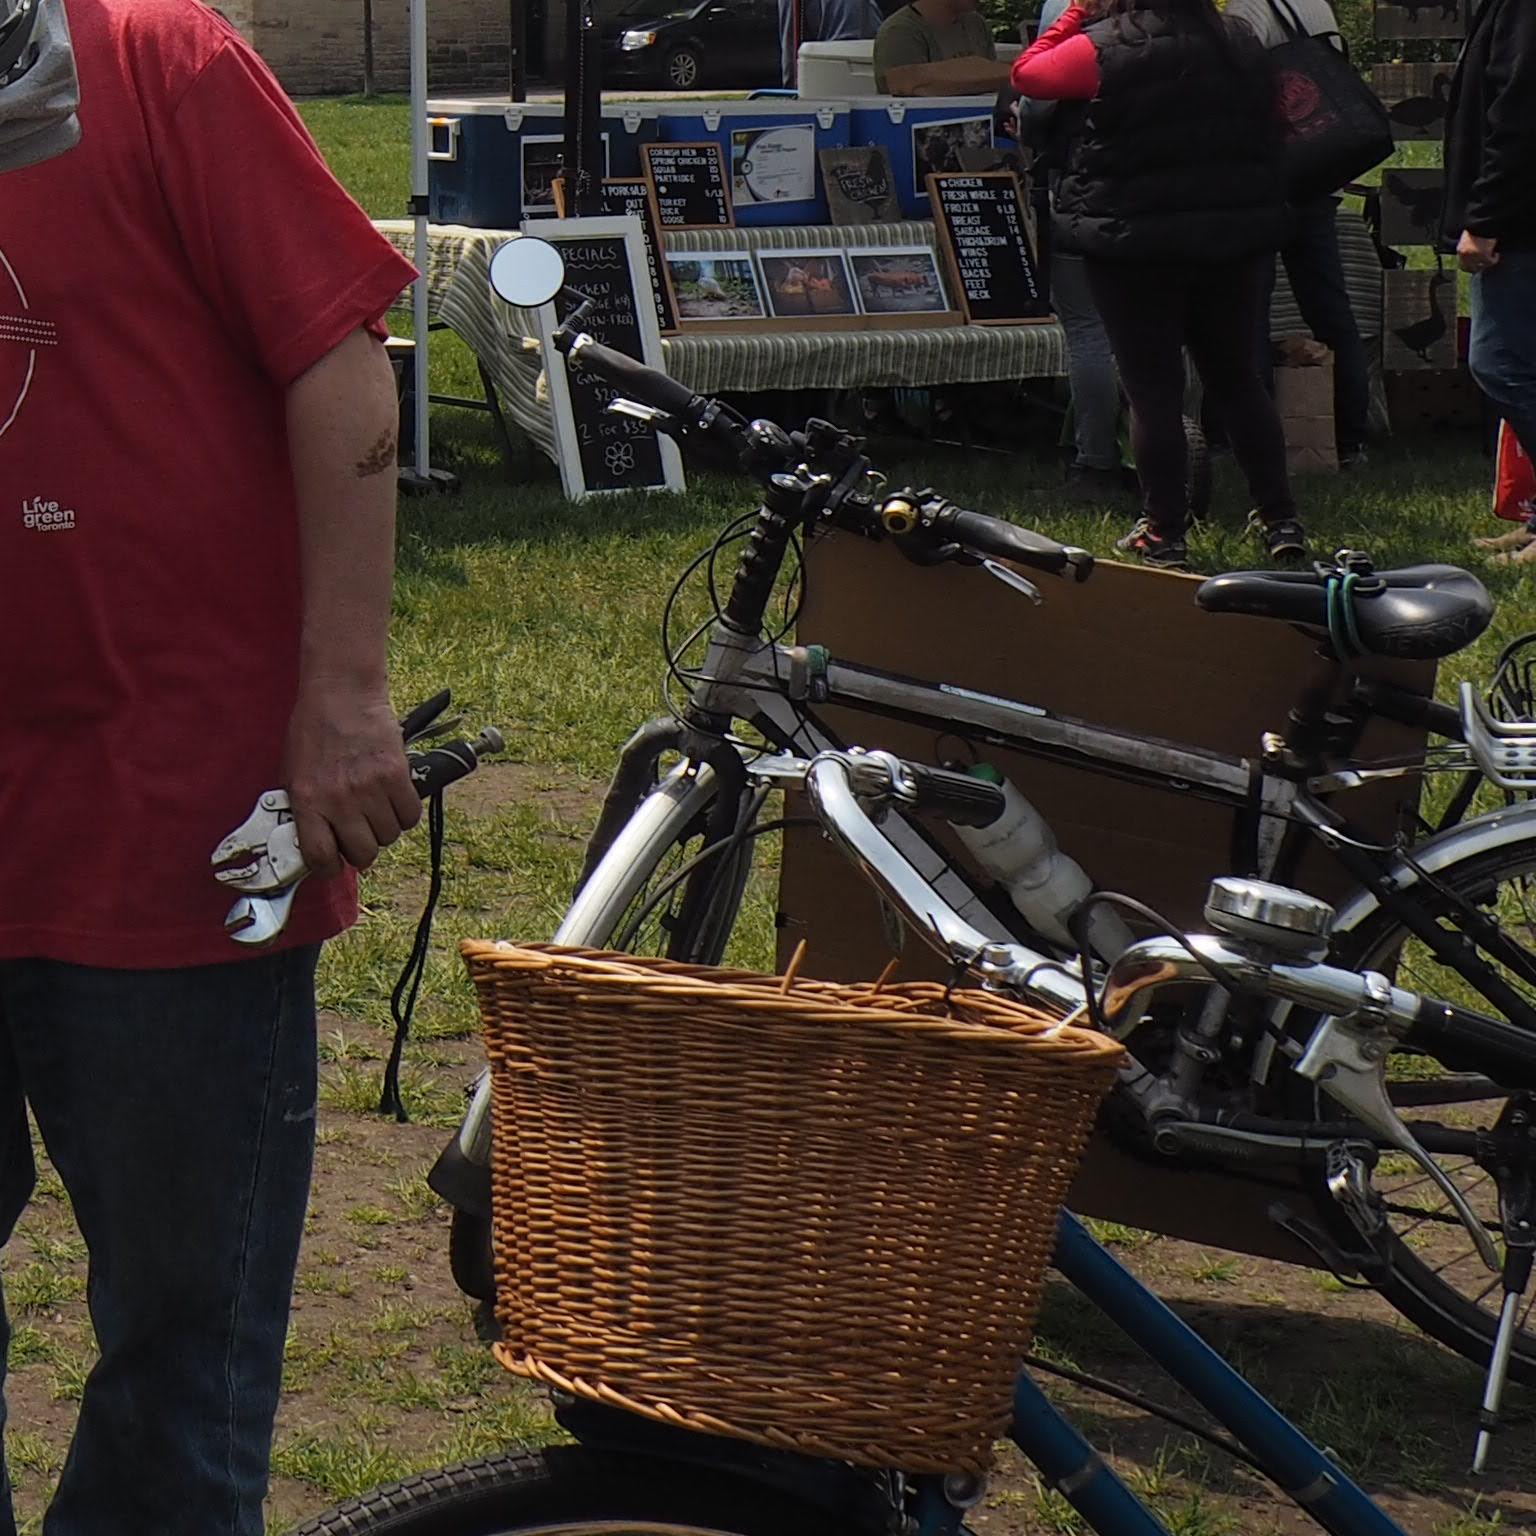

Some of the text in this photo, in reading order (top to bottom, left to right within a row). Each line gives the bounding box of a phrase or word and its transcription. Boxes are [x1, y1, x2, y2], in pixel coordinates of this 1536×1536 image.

[677, 157, 707, 165] CHICKEN
[948, 178, 983, 187] CHICKEN
[608, 186, 629, 196] PORK
[942, 190, 968, 200] FRESH
[969, 190, 997, 200] WHOLE
[626, 199, 644, 209] OUT
[659, 198, 686, 206] TURKEY
[660, 207, 679, 215] DUCK
[944, 203, 980, 213] FROZEN
[662, 216, 685, 224] GOOSE
[951, 216, 981, 225] BREAST
[954, 226, 991, 236] SAUSAGE
[561, 247, 617, 261] PECIALS
[960, 248, 988, 257] WINGS
[959, 258, 988, 268] LIVER
[962, 269, 992, 278] BACKS
[965, 279, 986, 289] FEET
[968, 290, 991, 300] NECK
[622, 420, 648, 434] $35
[23, 496, 59, 514] Live
[24, 510, 75, 528] green
[36, 520, 76, 532] Toronto
